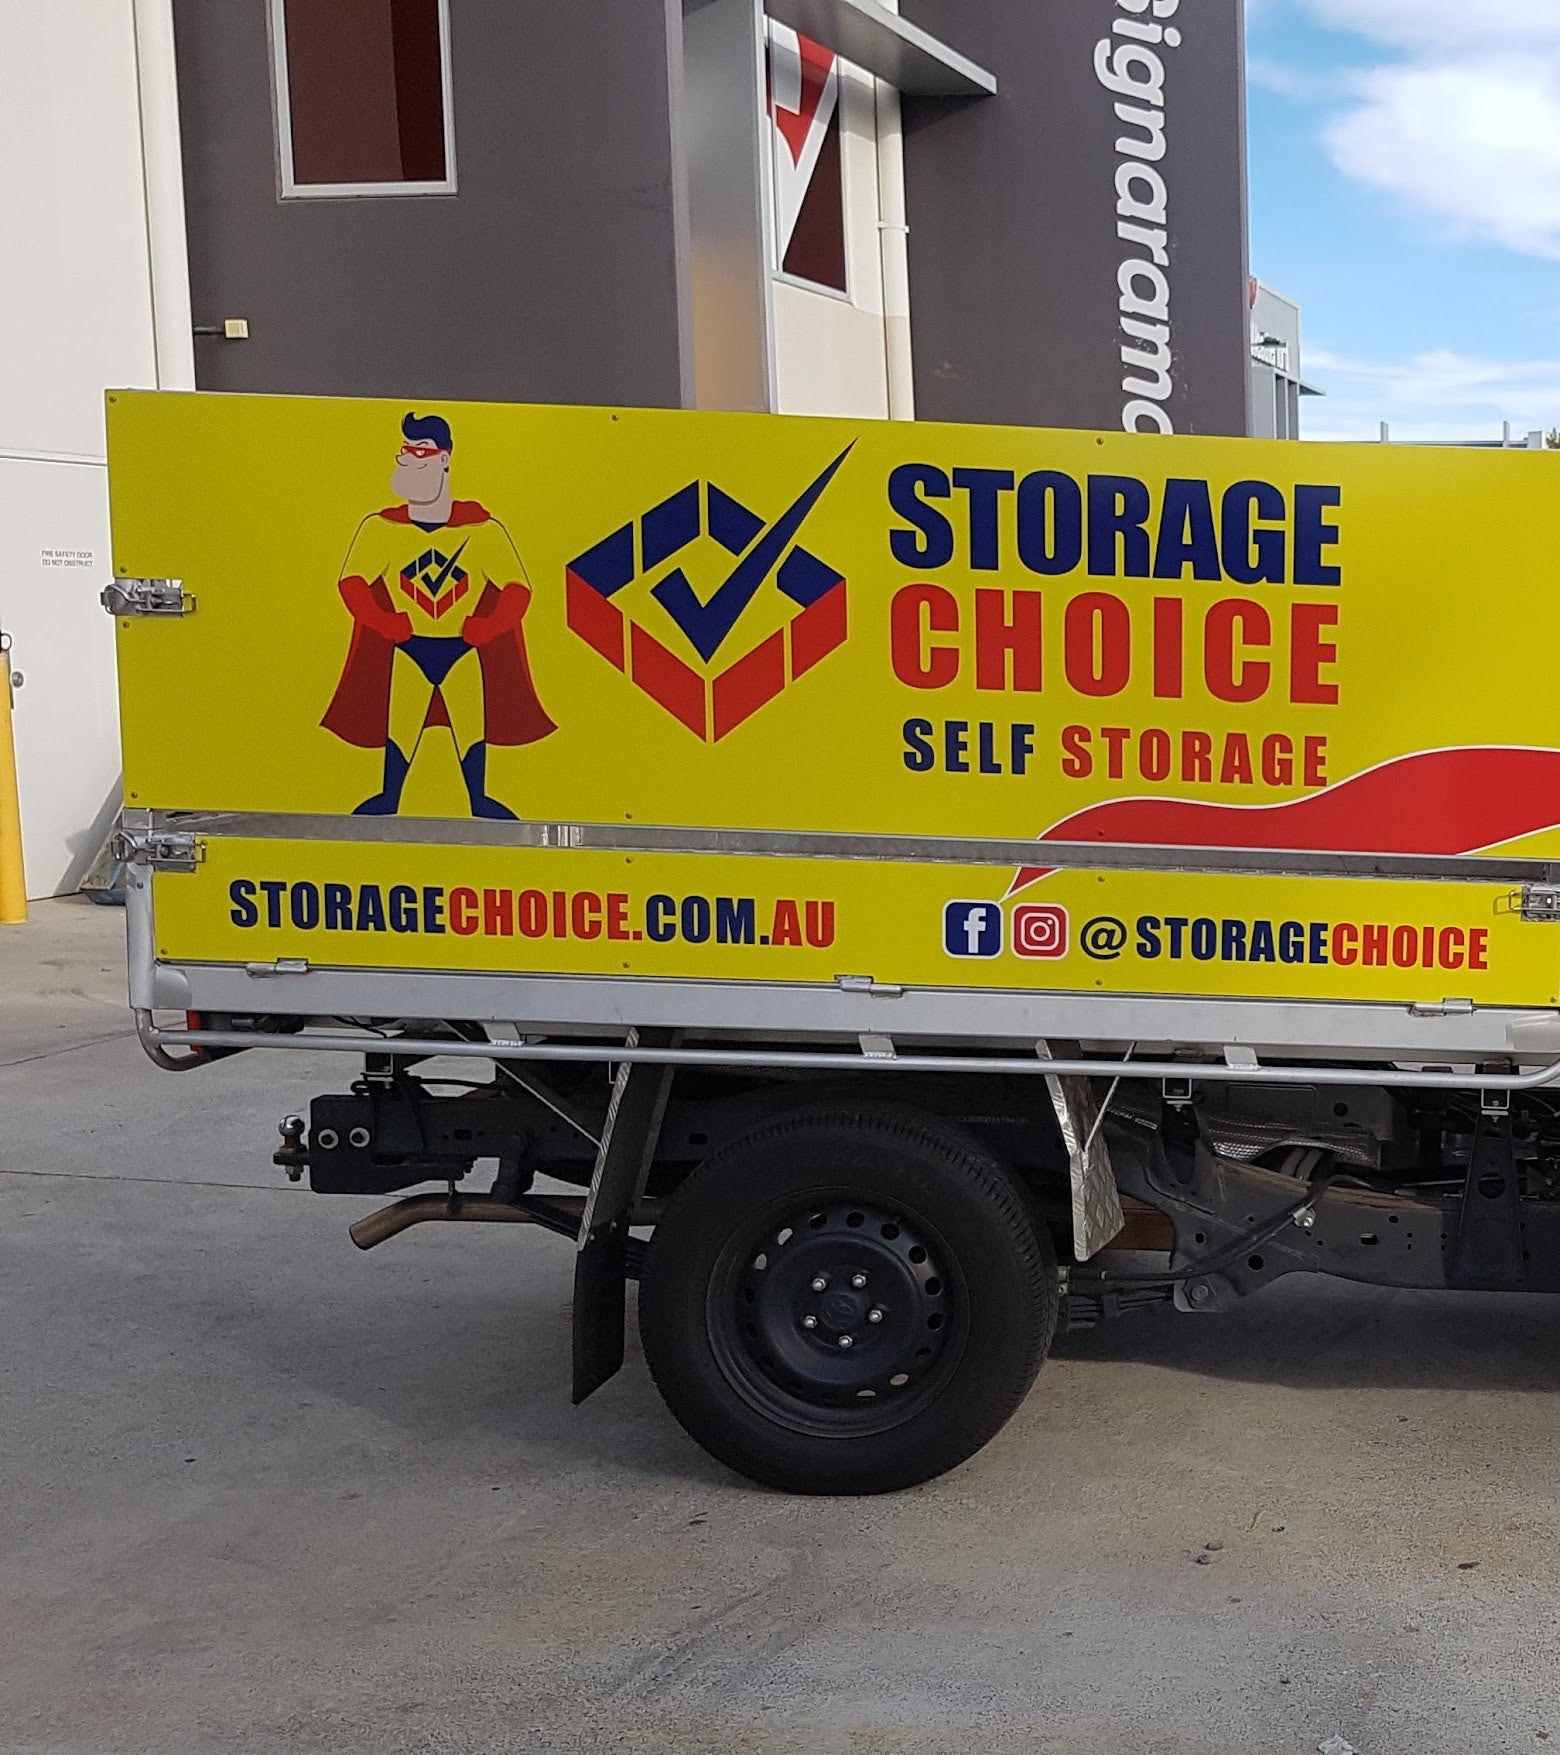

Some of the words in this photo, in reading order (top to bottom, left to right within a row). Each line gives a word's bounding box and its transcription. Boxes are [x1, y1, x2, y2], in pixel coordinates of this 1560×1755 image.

[888, 463, 1342, 587] STORAGE
[890, 583, 1340, 706] CHOICE
[902, 718, 1035, 775] SELF
[1061, 725, 1328, 788] STORAGE
[230, 879, 836, 949] STORAGECHOICE.COM.AU
